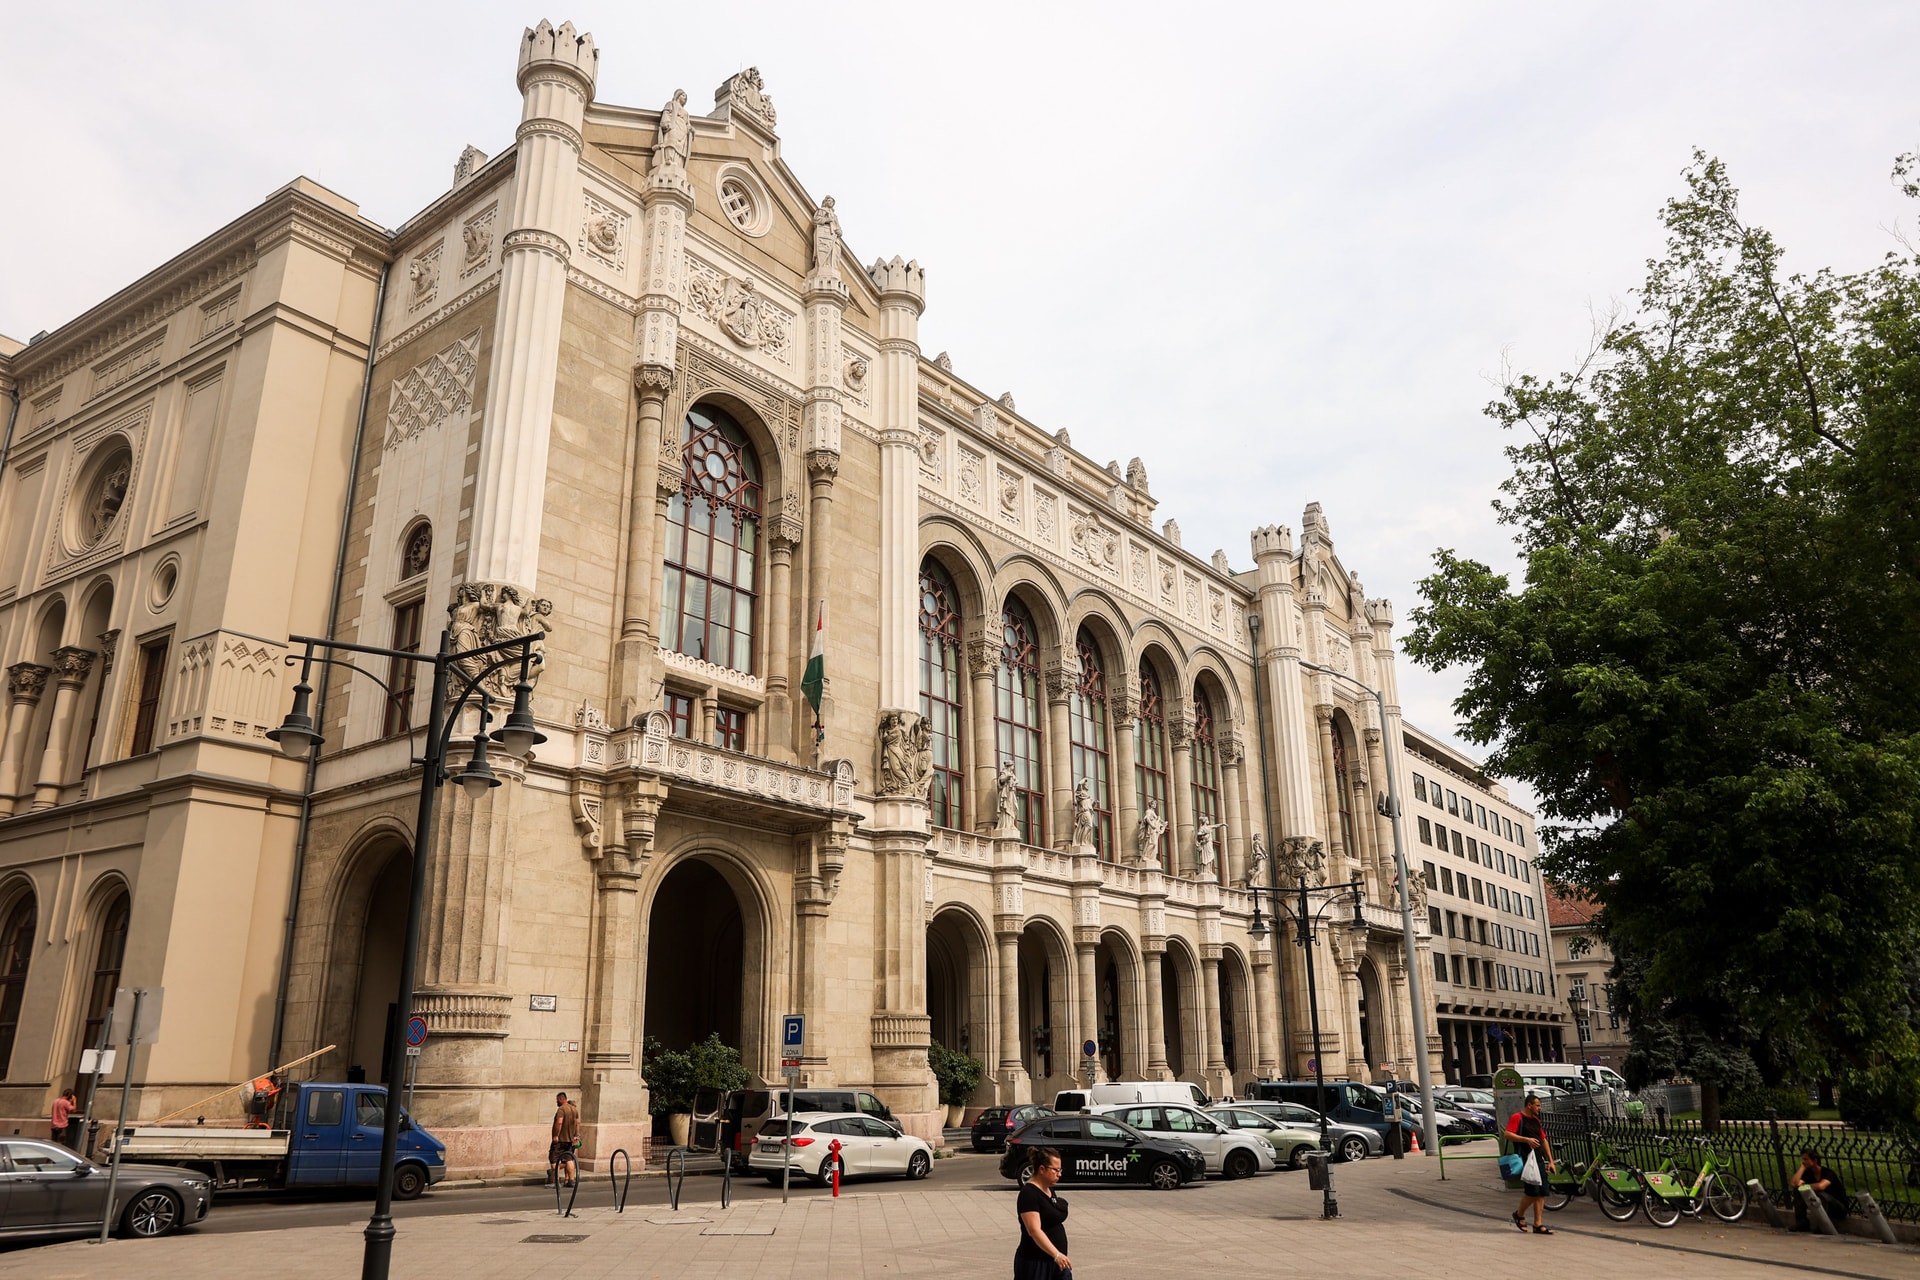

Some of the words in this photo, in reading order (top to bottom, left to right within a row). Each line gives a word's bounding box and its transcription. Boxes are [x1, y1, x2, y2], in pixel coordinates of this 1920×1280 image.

[788, 1023, 799, 1040] P
[1386, 1082, 1393, 1090] P
[1076, 1153, 1128, 1170] market
